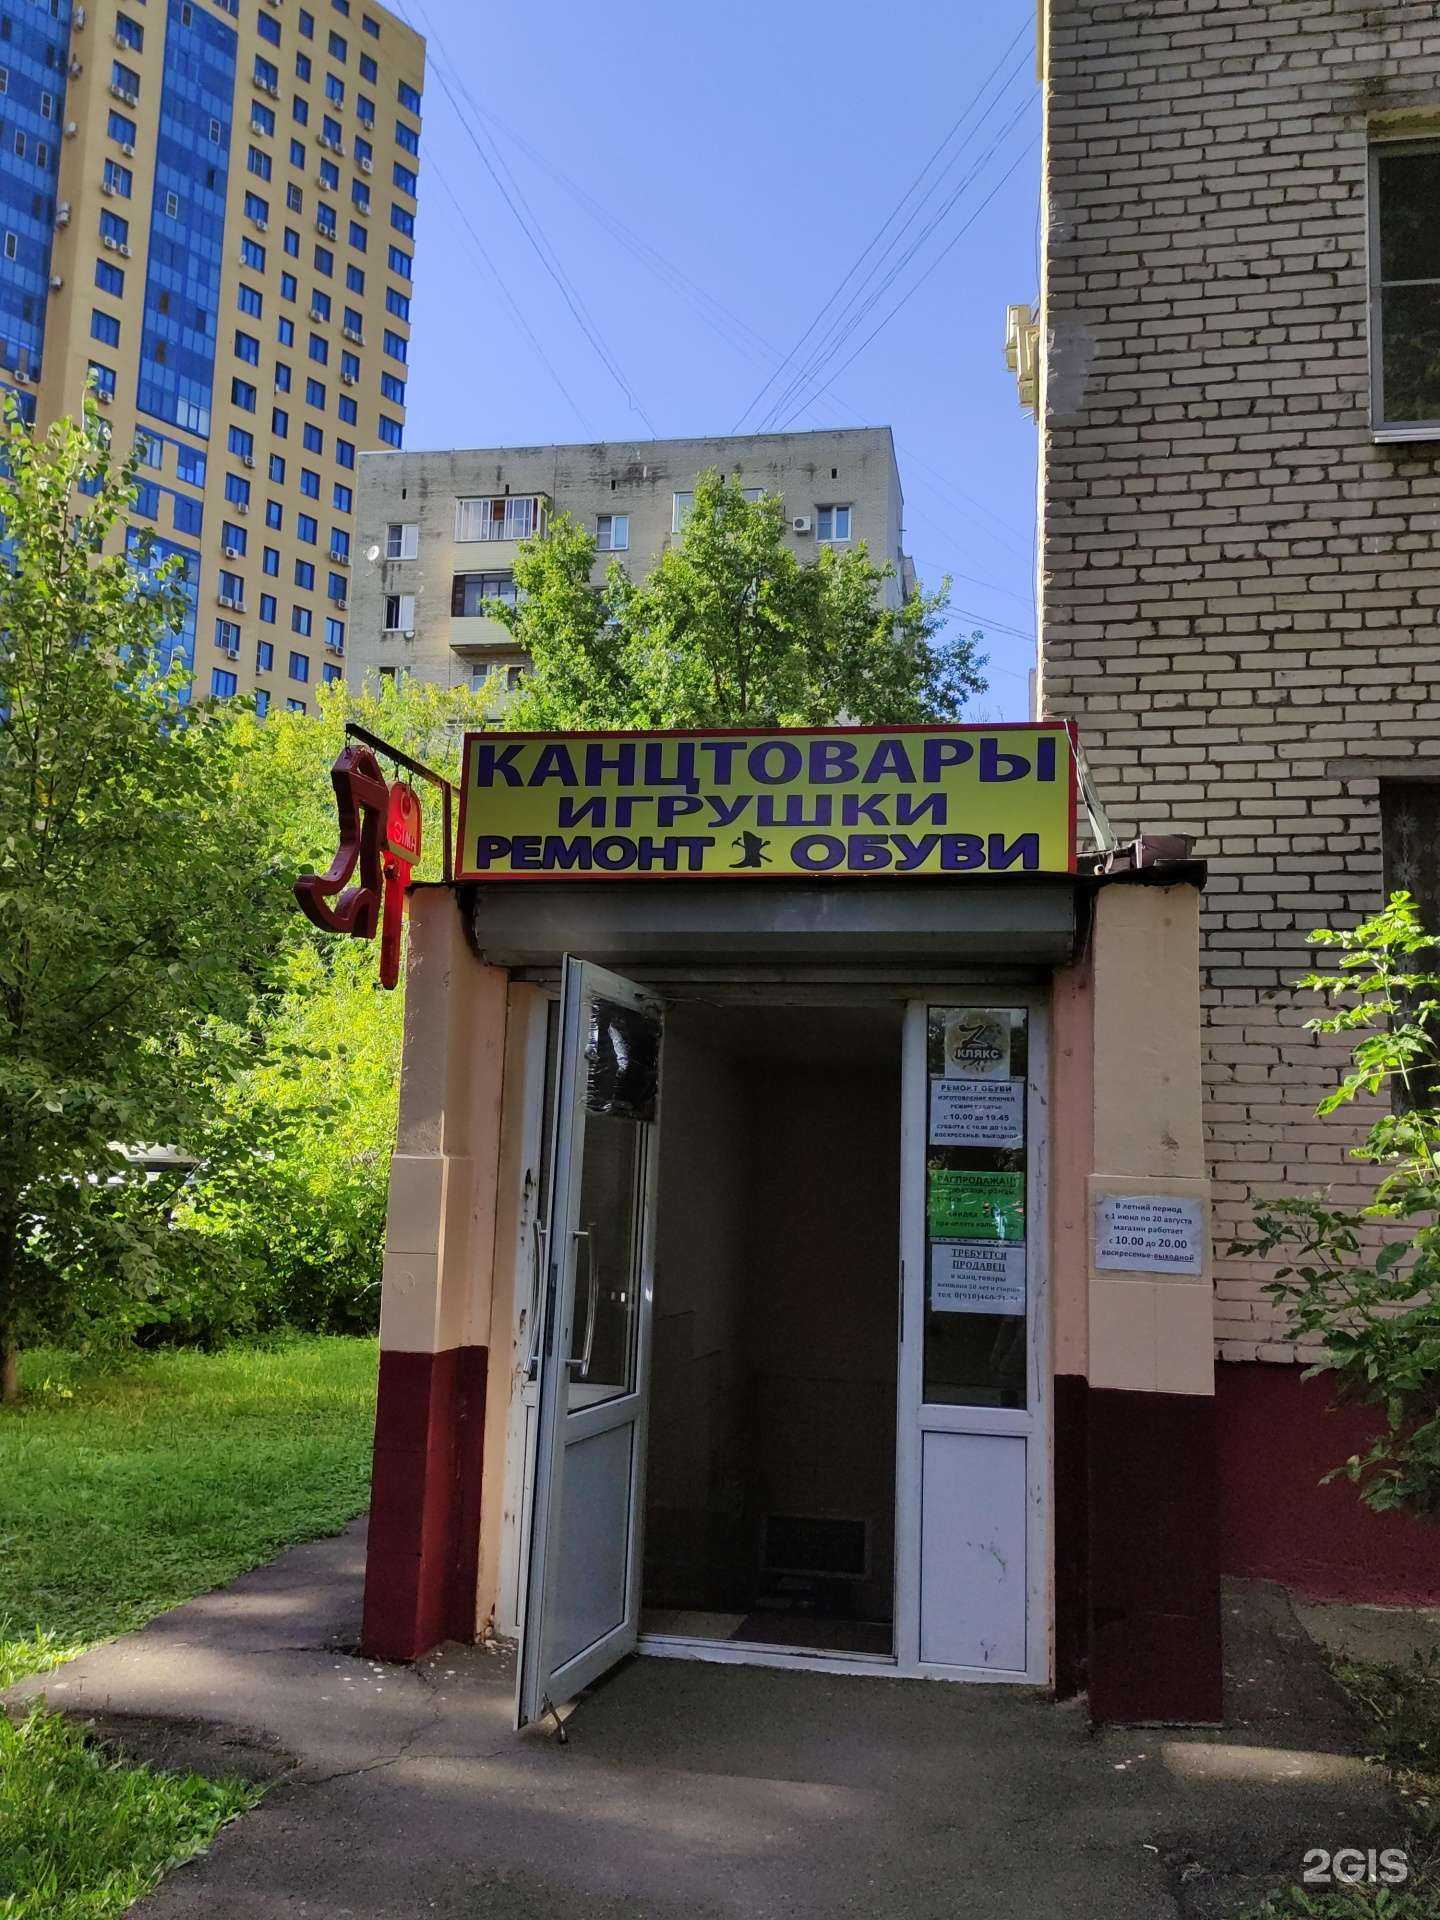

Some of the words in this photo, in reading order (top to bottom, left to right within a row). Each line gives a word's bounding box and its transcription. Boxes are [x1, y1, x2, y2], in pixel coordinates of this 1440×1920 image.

[477, 737, 1056, 794] КАНЦТОВАРЫ
[557, 792, 948, 829] ИГРУШКИ
[476, 835, 715, 870] РЕМОНТ
[791, 833, 1040, 871] ОБУВИ
[941, 1084, 977, 1092] РЕМОНТ
[950, 1113, 973, 1121] 10.00
[986, 1114, 1010, 1122] 19.45
[1123, 1203, 1150, 1211] летний
[1153, 1206, 1182, 1214] период
[1152, 1215, 1162, 1223] 20
[1164, 1217, 1192, 1225] августа
[1148, 1226, 1183, 1235] работает
[1116, 1236, 1144, 1246] 10.00
[1158, 1238, 1187, 1249] 20.00
[952, 1249, 1007, 1260] ТРЕБУЕТСЯ
[952, 1260, 1006, 1272] ПРОДАВЕЦ
